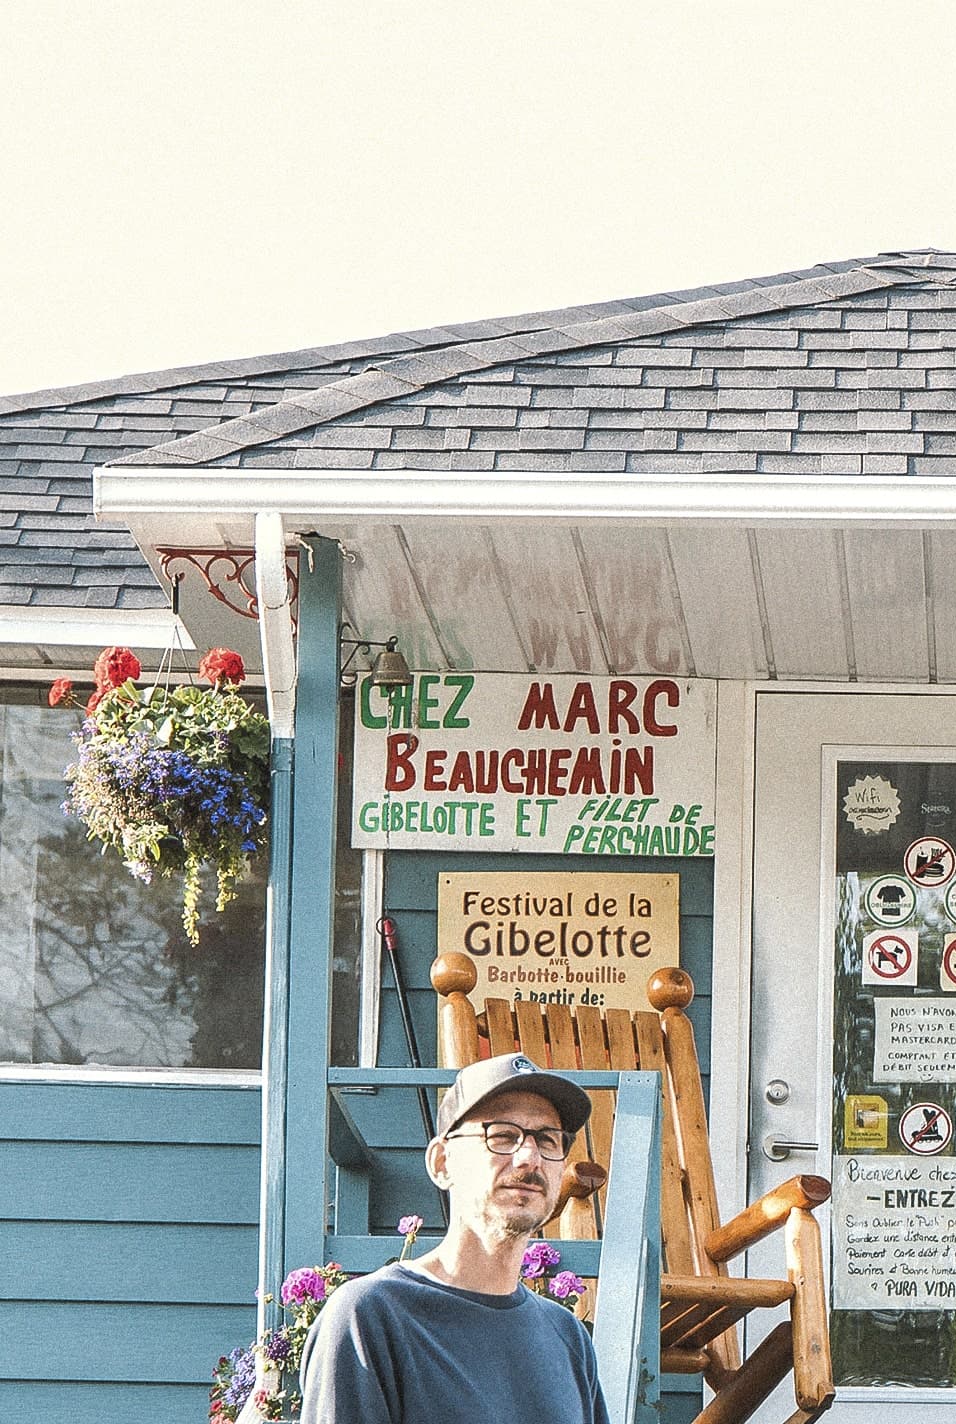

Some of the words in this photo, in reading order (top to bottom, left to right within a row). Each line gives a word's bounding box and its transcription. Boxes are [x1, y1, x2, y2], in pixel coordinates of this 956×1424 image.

[360, 674, 475, 730] CHEZ
[517, 679, 681, 737] MARC
[358, 796, 496, 837] GIBELOTTE
[516, 798, 560, 838] ET
[578, 795, 660, 823] FILET
[669, 804, 704, 824] DE
[562, 824, 716, 857] PERCHAUDE
[463, 891, 573, 917] Festival
[585, 892, 618, 918] de
[629, 893, 652, 918] la
[464, 920, 652, 959] Gibelotte
[549, 958, 570, 966] AVEC
[581, 987, 605, 1006] de:
[890, 1007, 916, 1018] NOUS
[890, 1022, 912, 1032] PAS
[917, 1023, 944, 1032] VISA
[887, 1052, 936, 1060] COMPTANT
[883, 1063, 912, 1071] DÉBIT
[847, 1158, 922, 1182] Bienvenue
[906, 1217, 915, 1228] le
[847, 1232, 880, 1244] Gardez
[884, 1234, 900, 1243] une
[903, 1230, 939, 1243] distance
[846, 1247, 887, 1260] Paiement
[942, 1245, 951, 1258] et
[847, 1262, 884, 1275] Sourires
[884, 1278, 918, 1297] PURA
[924, 1279, 956, 1298] VIDA
